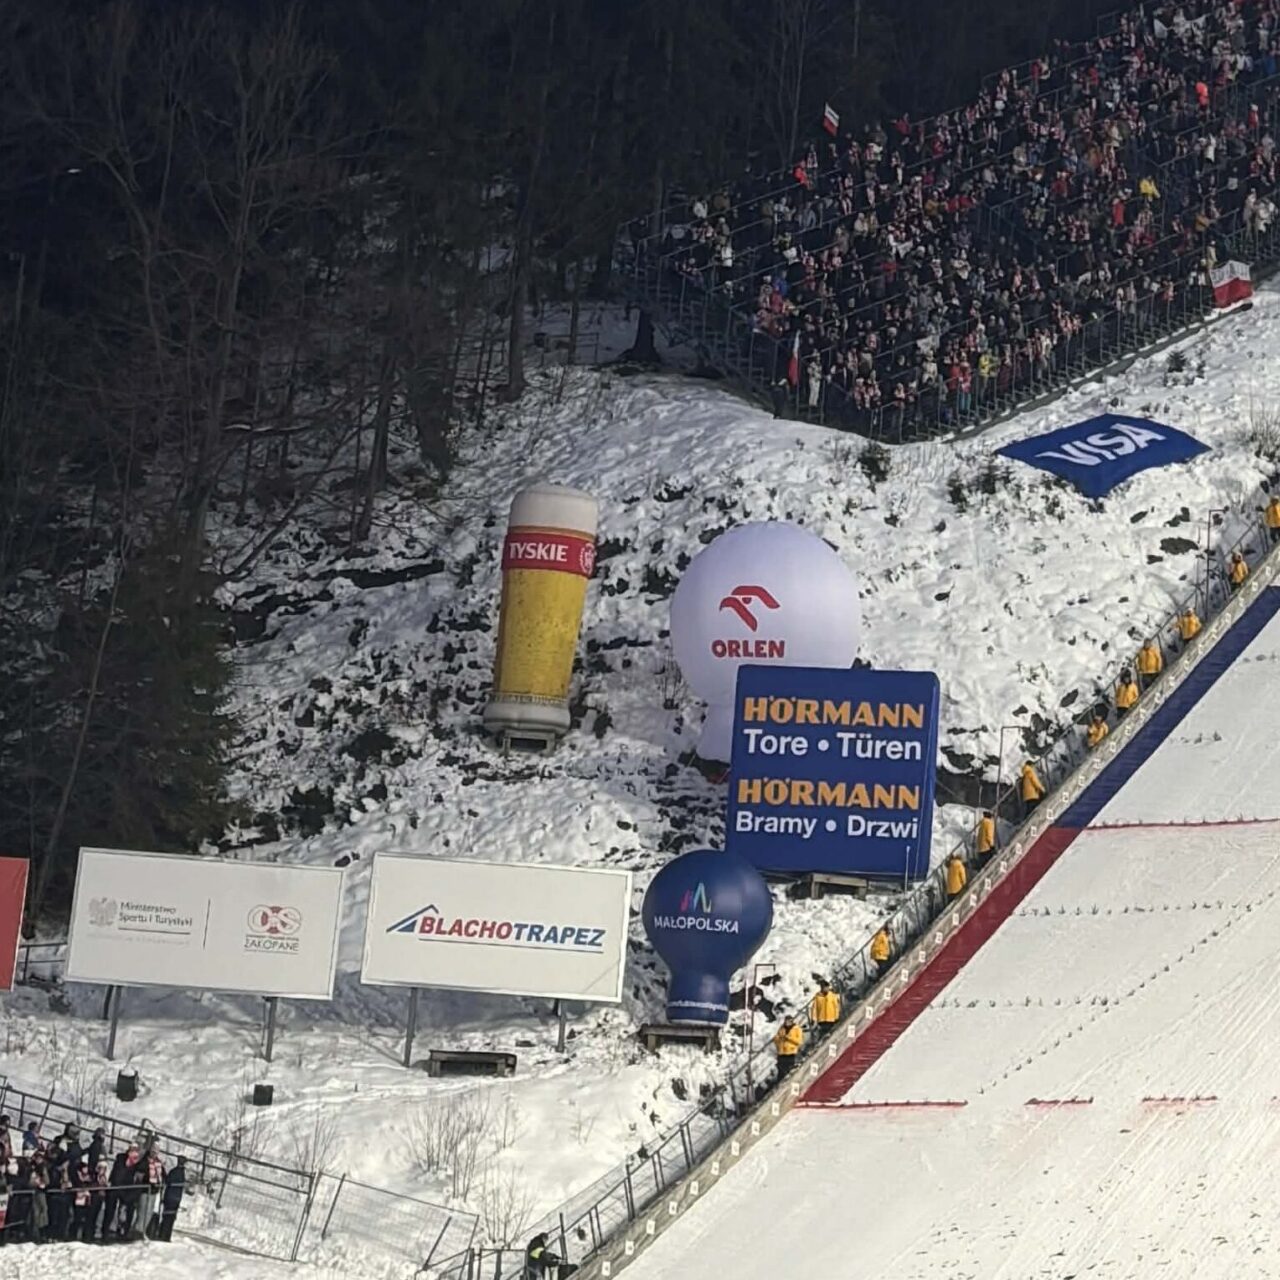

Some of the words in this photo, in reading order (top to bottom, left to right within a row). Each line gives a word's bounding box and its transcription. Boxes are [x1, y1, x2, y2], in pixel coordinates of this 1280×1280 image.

[1034, 423, 1167, 466] VISA
[509, 542, 569, 562] TYSKIE
[711, 639, 785, 658] ORLEN
[743, 695, 924, 728] HÖRMANN
[743, 728, 809, 755] Tore
[836, 732, 922, 760] Türen
[737, 777, 920, 810] HÖRMANN
[735, 810, 818, 839] Bramy
[847, 815, 919, 839] Drzwi
[418, 916, 606, 947] BLACHOTRAPEZ
[654, 915, 739, 934] MAŁOPOLSKA
[244, 938, 300, 952] ZAKOPANE
